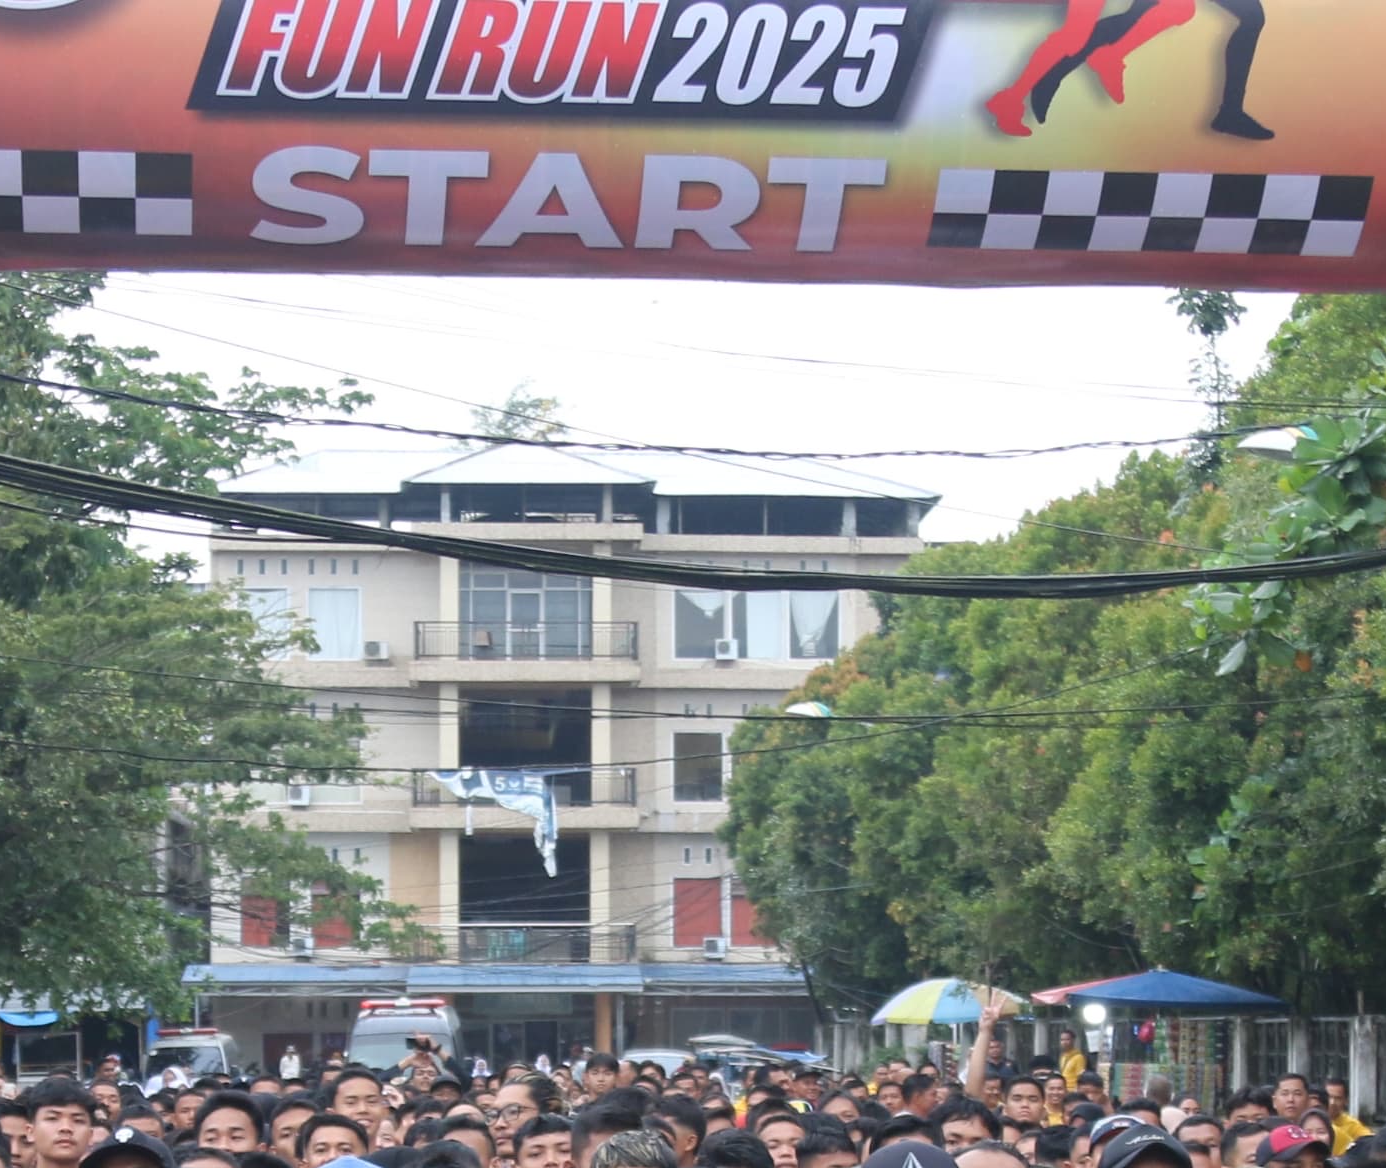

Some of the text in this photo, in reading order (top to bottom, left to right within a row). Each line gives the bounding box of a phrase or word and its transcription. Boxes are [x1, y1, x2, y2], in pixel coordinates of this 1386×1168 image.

[216, 0, 905, 108] FUN RUN 2025
[249, 145, 888, 252] START
